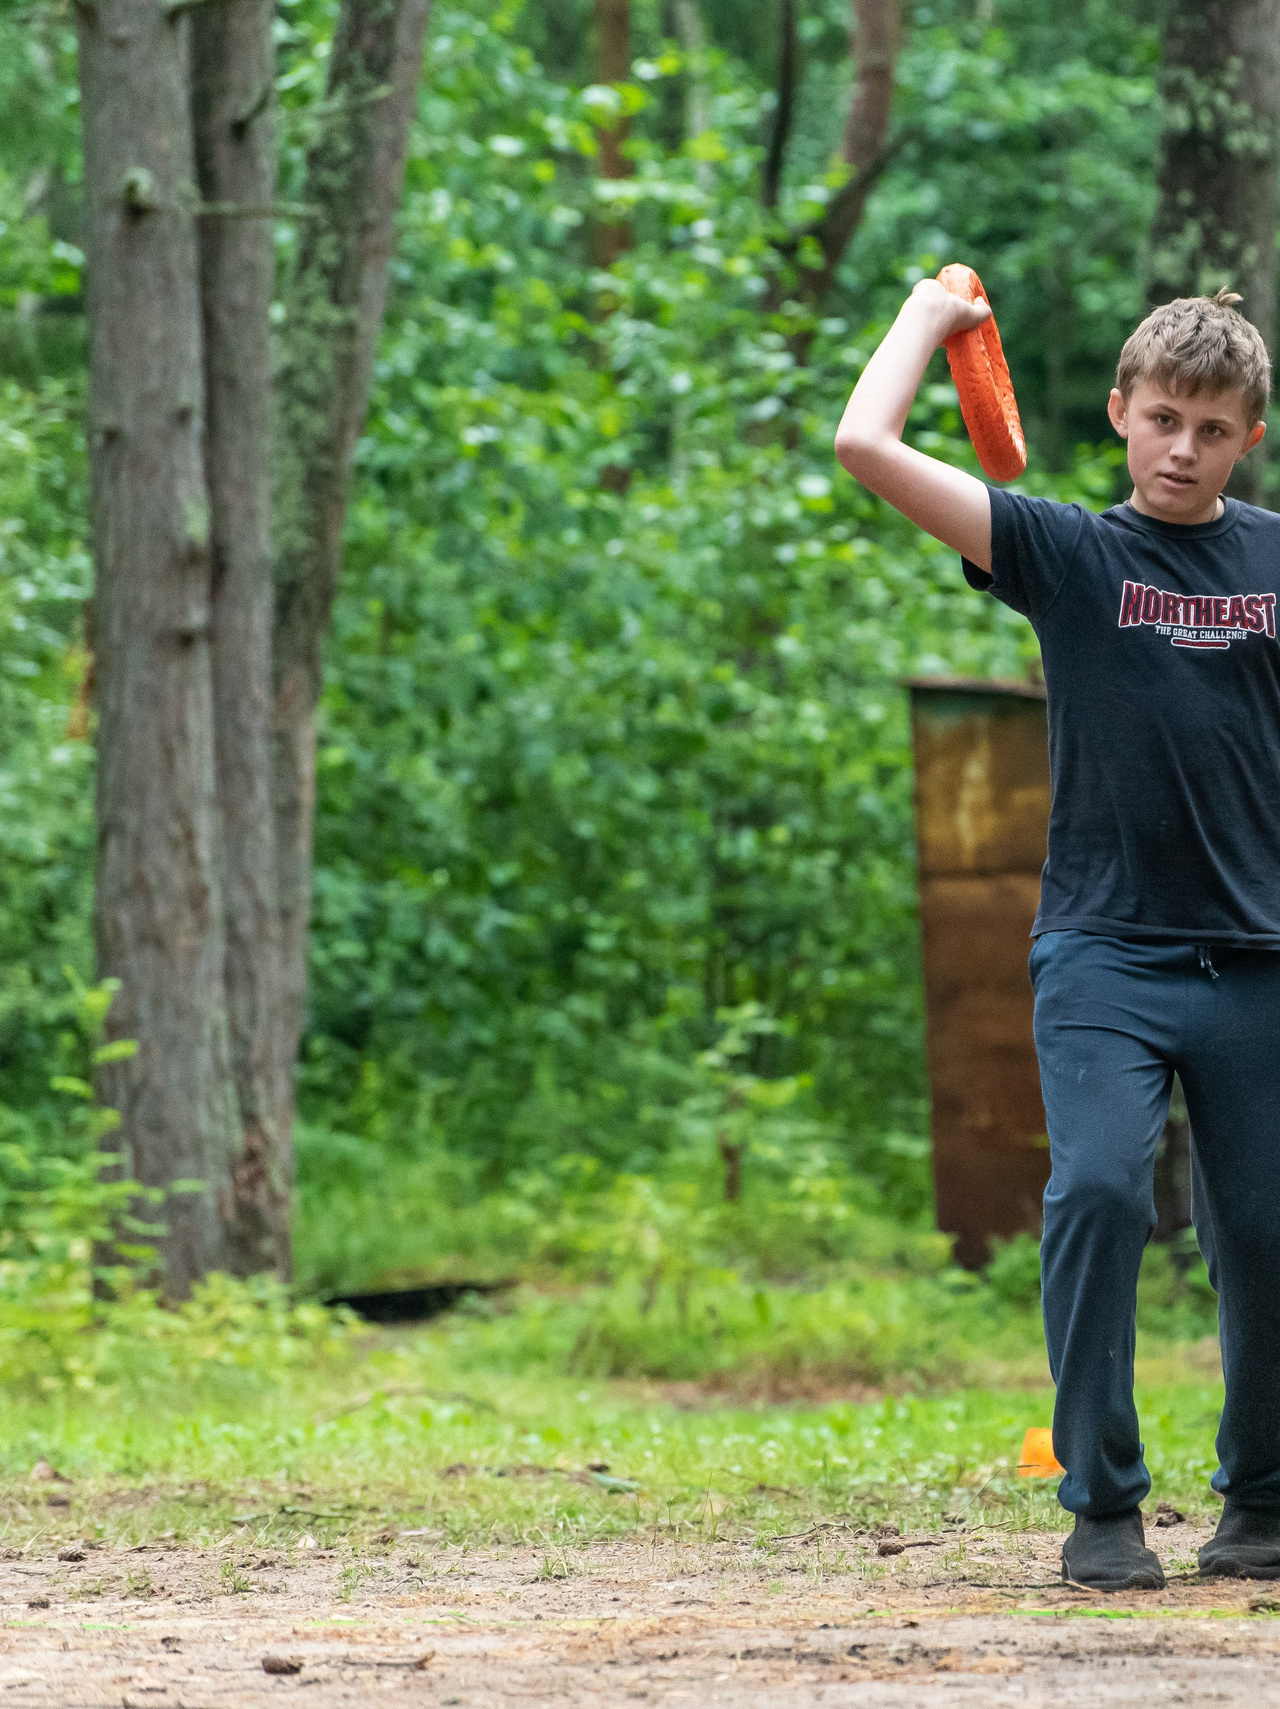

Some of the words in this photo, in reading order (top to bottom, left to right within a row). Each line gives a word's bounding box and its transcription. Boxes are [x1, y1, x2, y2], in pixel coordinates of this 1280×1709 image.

[1119, 581, 1276, 638] NORTHEAST
[1155, 625, 1171, 635] THE
[1173, 628, 1197, 639] GREAT
[1200, 631, 1247, 639] CHALLENGE
